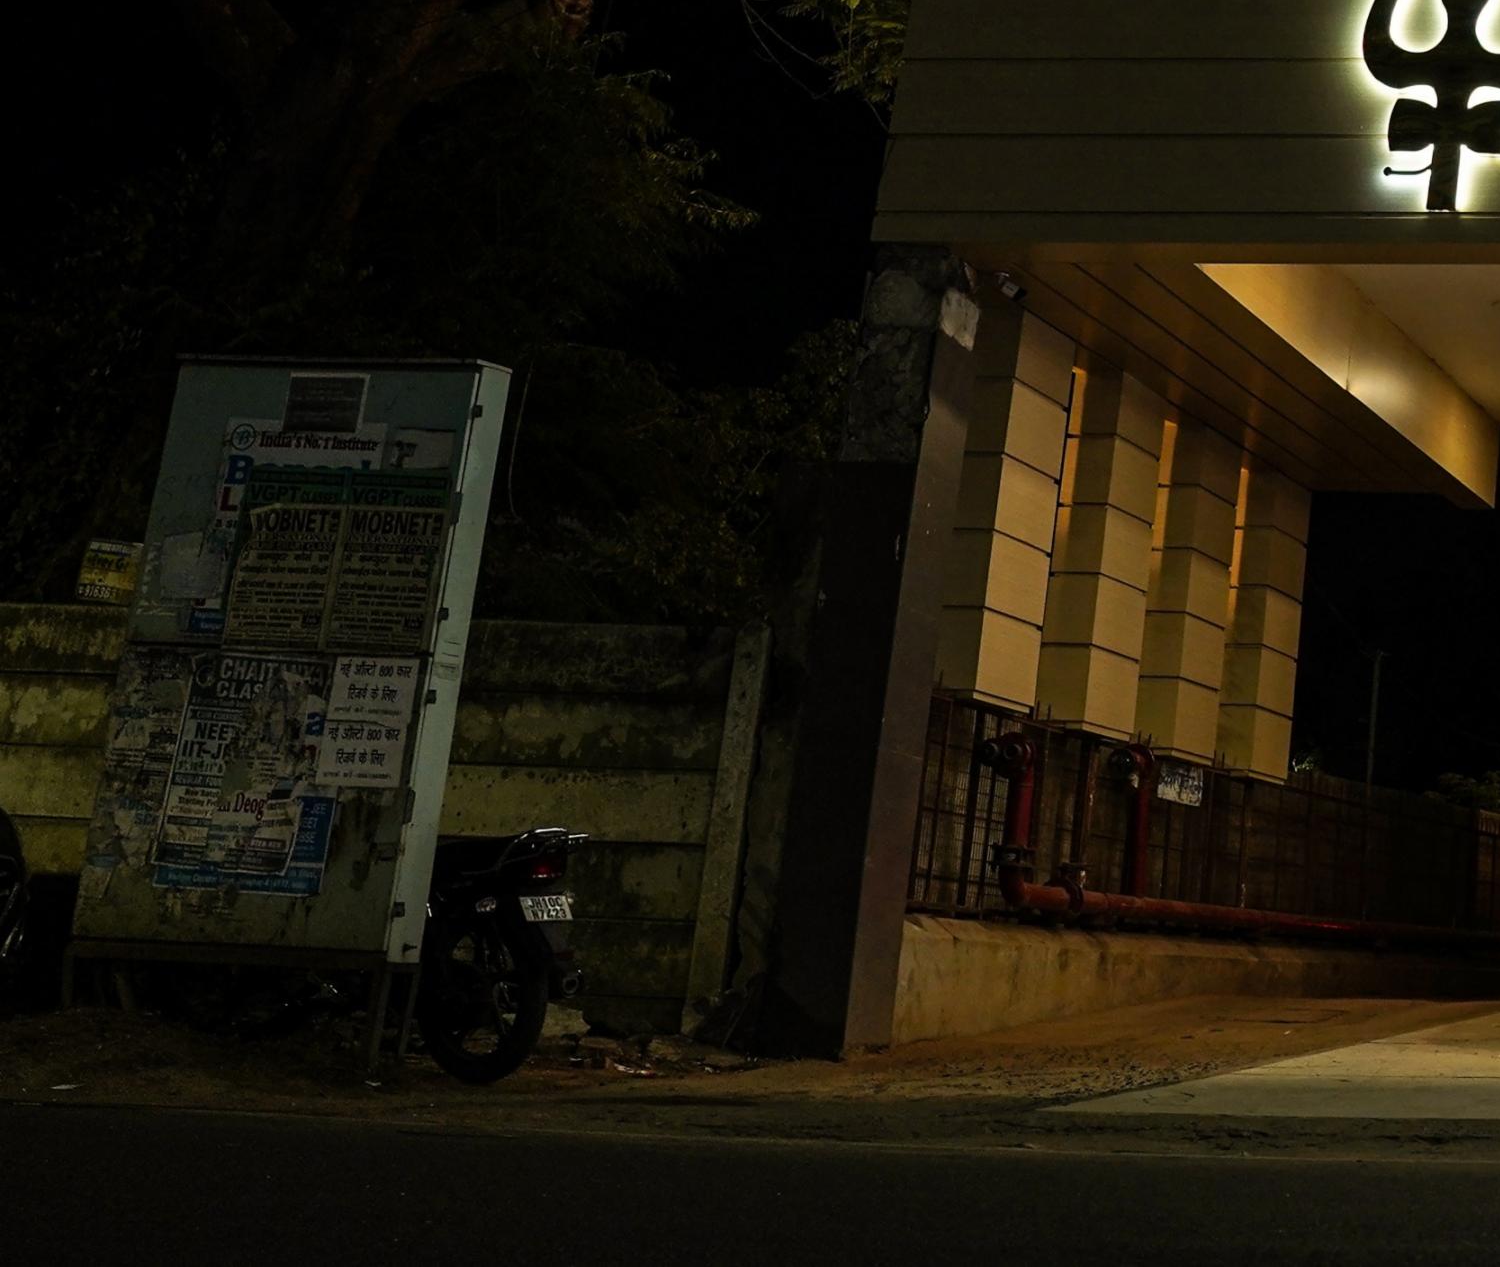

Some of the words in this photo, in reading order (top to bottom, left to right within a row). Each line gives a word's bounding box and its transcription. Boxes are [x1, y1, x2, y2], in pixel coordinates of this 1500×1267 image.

[259, 431, 303, 449] India's
[331, 435, 379, 452] Institute
[250, 484, 303, 503] VGPT
[352, 487, 404, 506] VGPT
[350, 512, 432, 536] MOBNET
[341, 659, 352, 678] नई
[379, 665, 393, 678] 800
[397, 665, 412, 678] कार
[370, 684, 380, 700] के
[381, 685, 398, 703] लिए
[328, 723, 340, 742] नई
[366, 728, 382, 741] 800
[384, 728, 400, 741] कार
[358, 749, 368, 764] के
[370, 749, 386, 766] लिए
[528, 897, 564, 909] JH10C
